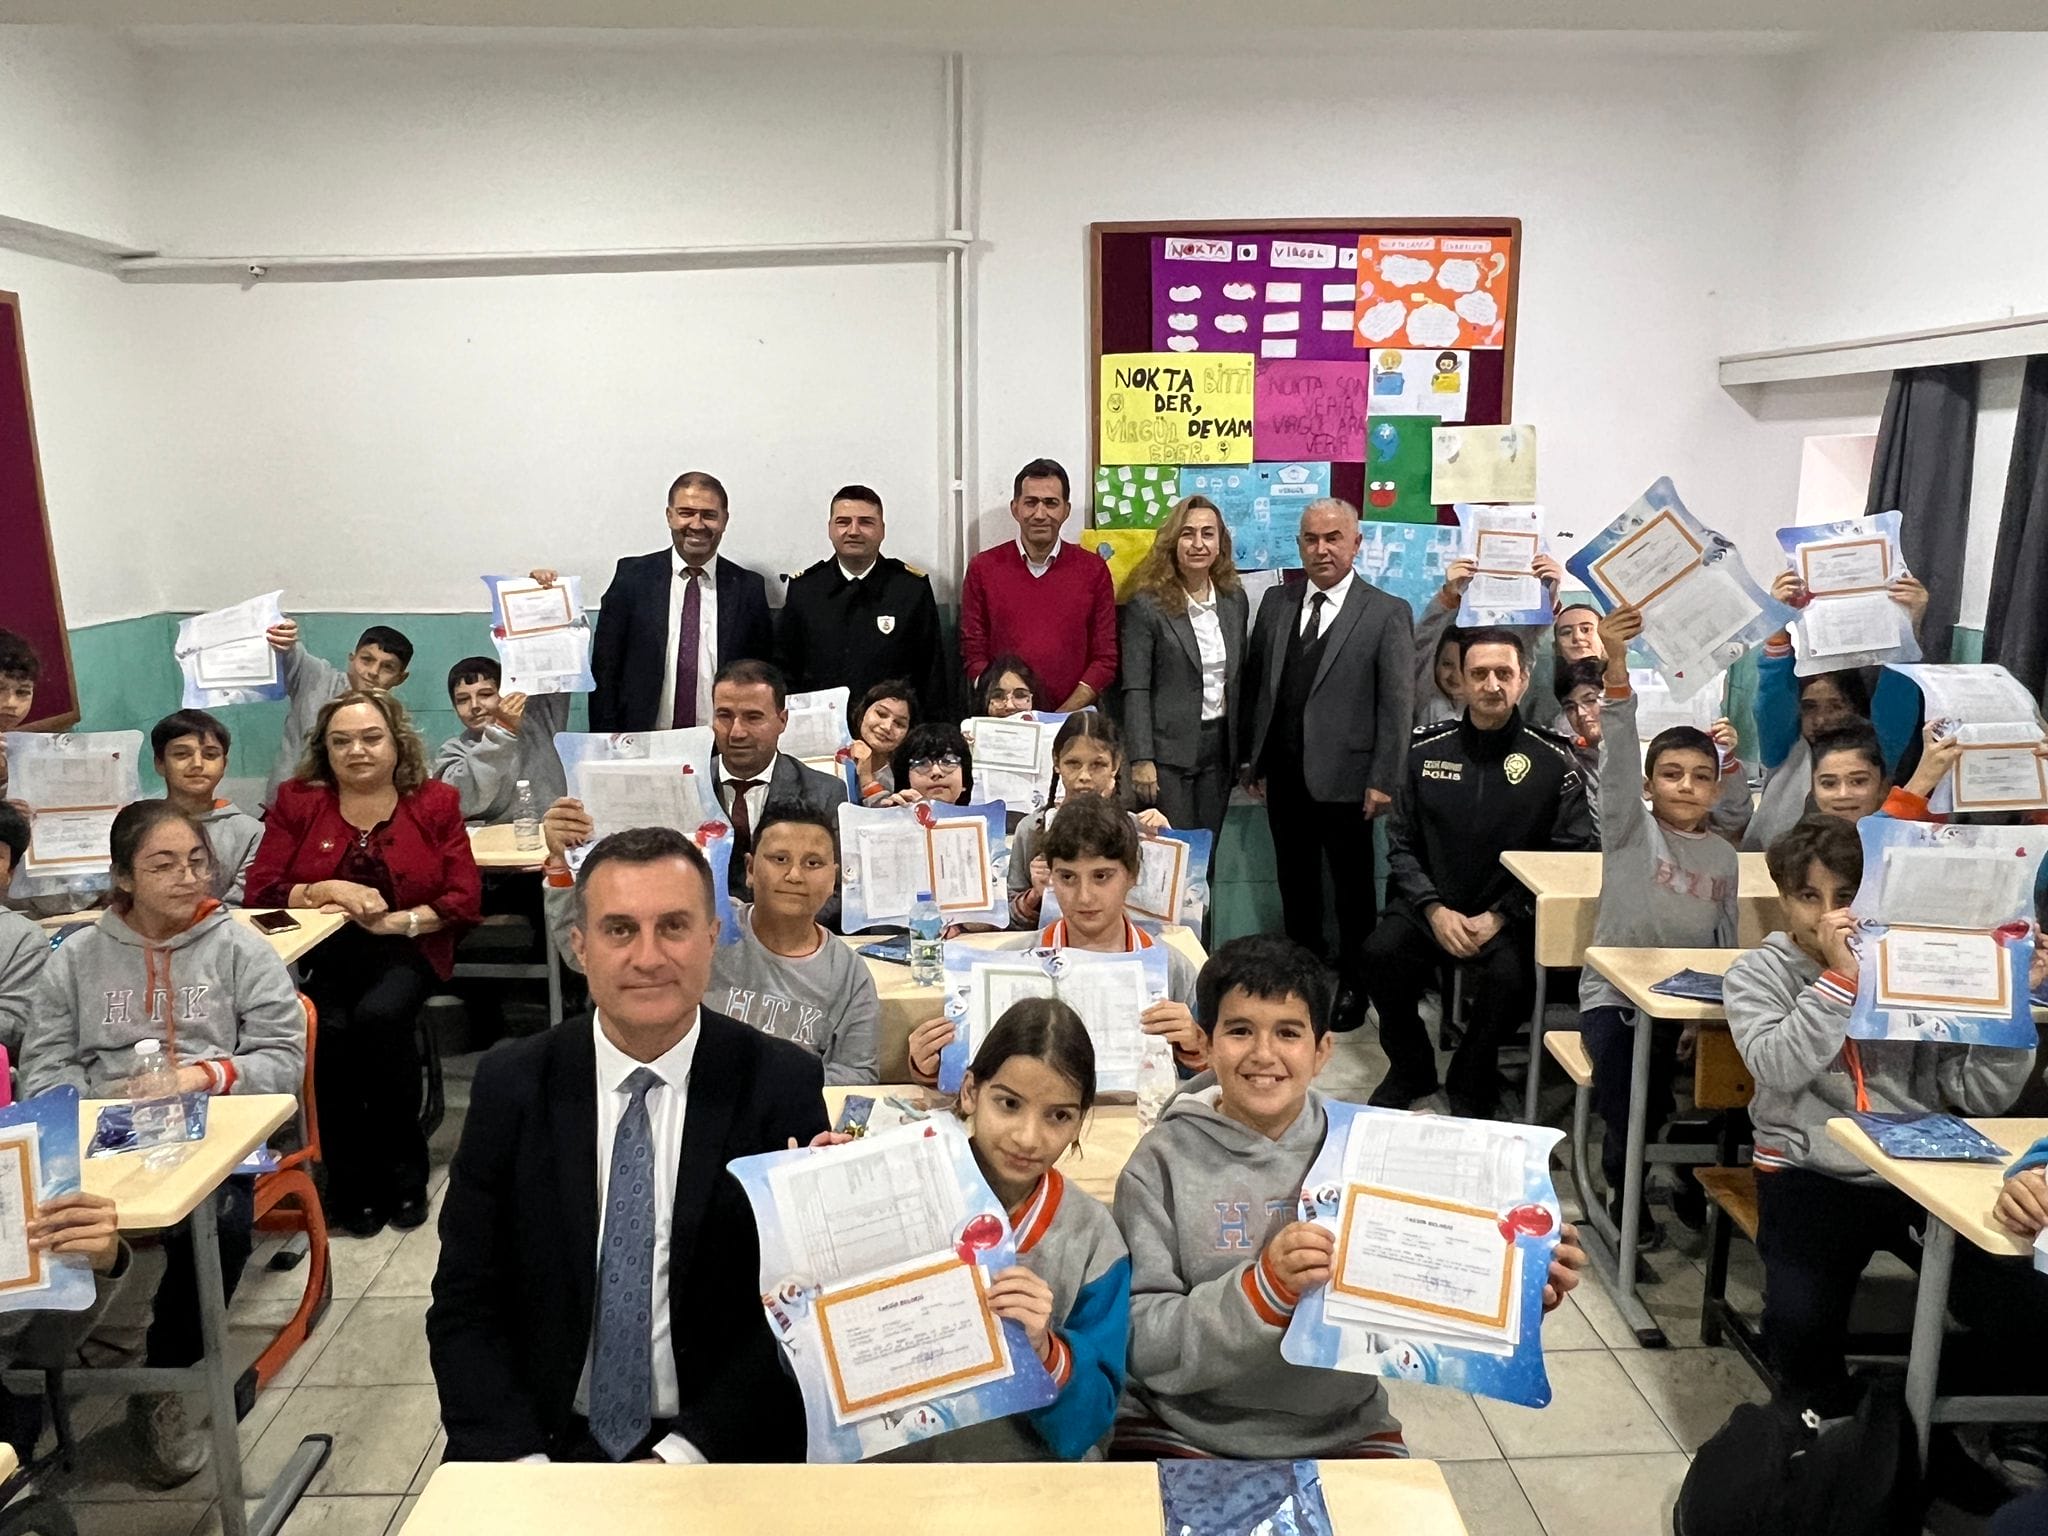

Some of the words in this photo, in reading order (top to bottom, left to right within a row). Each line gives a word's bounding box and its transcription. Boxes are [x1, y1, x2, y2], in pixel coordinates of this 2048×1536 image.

[1171, 241, 1225, 258] NOKTA
[1115, 367, 1194, 393] NOKTA
[1154, 393, 1202, 416] DER,
[1188, 417, 1253, 439] DEVAM
[724, 986, 823, 1045] HTK
